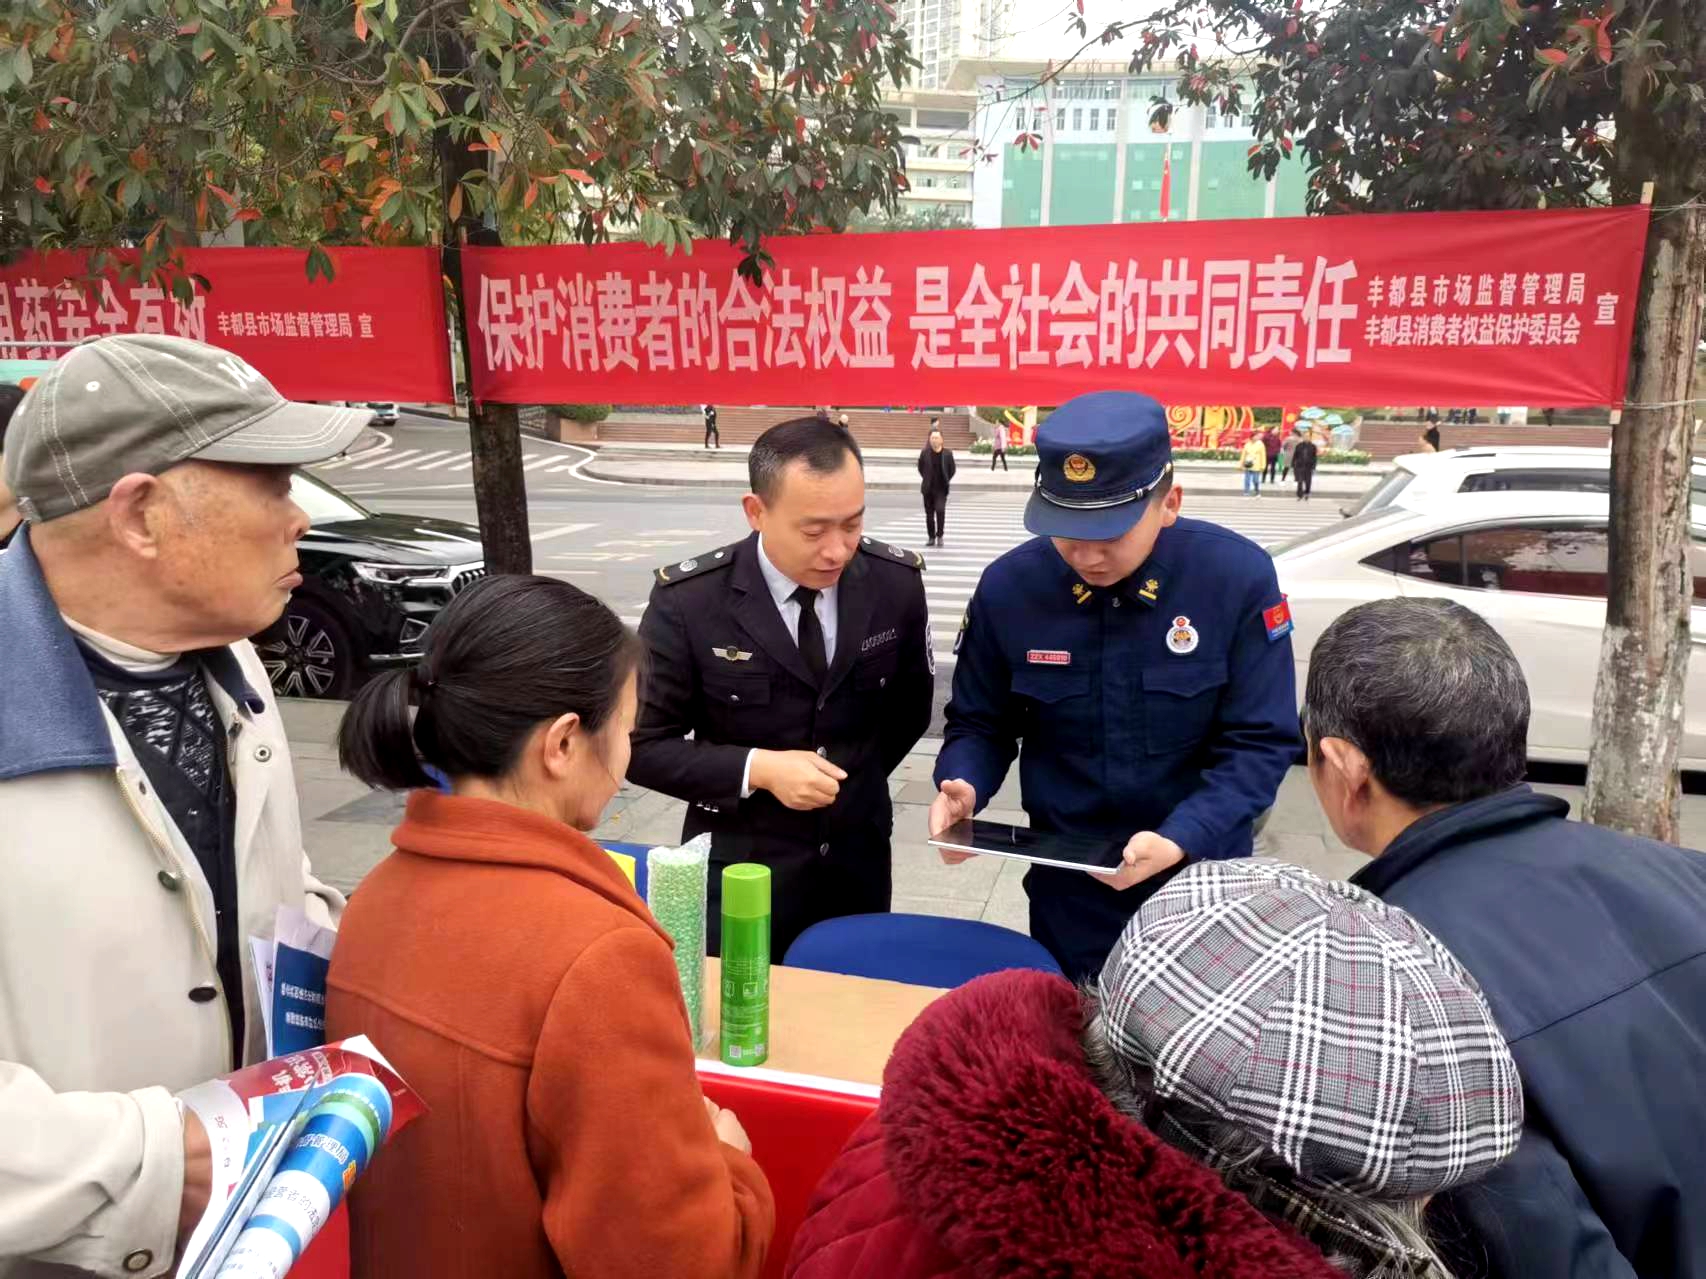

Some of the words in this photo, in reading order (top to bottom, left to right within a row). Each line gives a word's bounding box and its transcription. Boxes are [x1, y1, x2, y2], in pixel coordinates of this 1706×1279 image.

[1366, 272, 1586, 308] 丰都县市场监督管理局
[217, 311, 353, 338] 丰都县市场监督管理局
[358, 312, 375, 338] 宣
[478, 265, 895, 372] 保护消费者的合法权益
[909, 254, 1359, 371] 是全社会的共同责任
[1594, 292, 1618, 326] 宣
[1364, 313, 1582, 348] 丰都县消费者权益保护委员会
